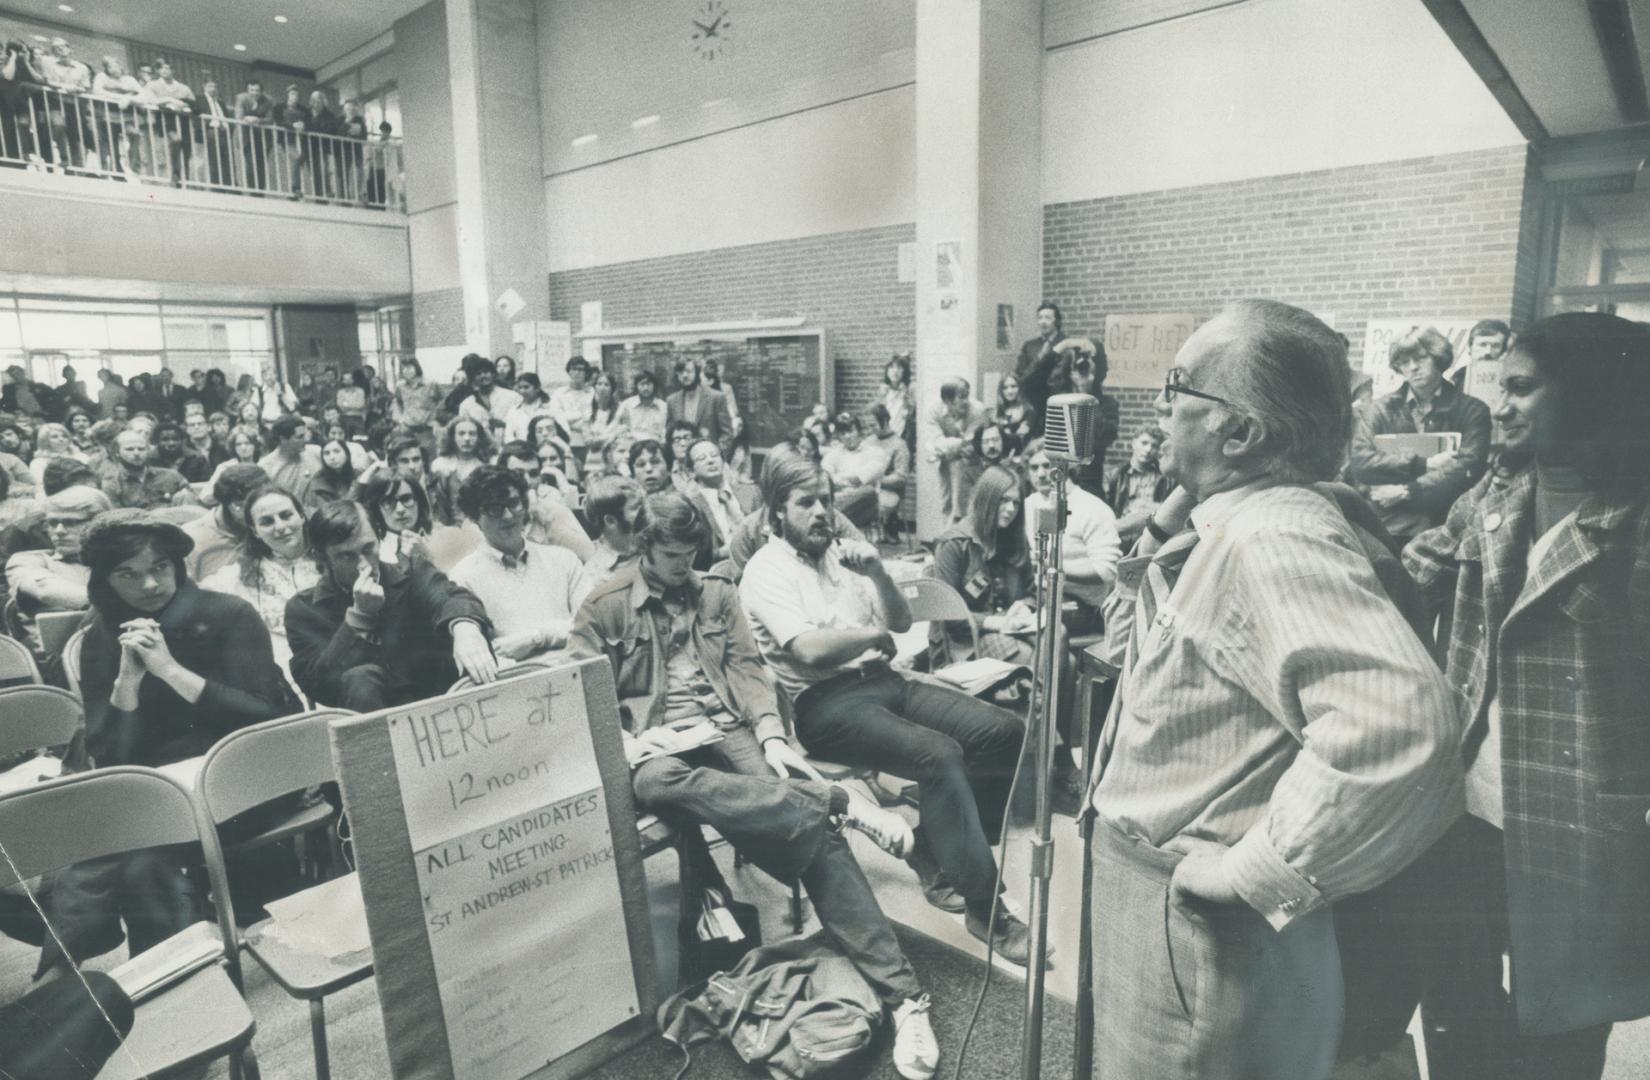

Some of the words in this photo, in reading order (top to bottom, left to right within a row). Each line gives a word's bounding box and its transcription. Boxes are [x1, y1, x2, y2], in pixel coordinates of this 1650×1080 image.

[408, 694, 510, 768] HERE
[527, 683, 561, 727] at
[447, 771, 485, 811] 12
[487, 756, 550, 797] noon
[426, 844, 474, 874] ALL
[480, 794, 599, 851] CANDIDATES
[488, 834, 569, 881] MEETING
[428, 907, 454, 936] ST
